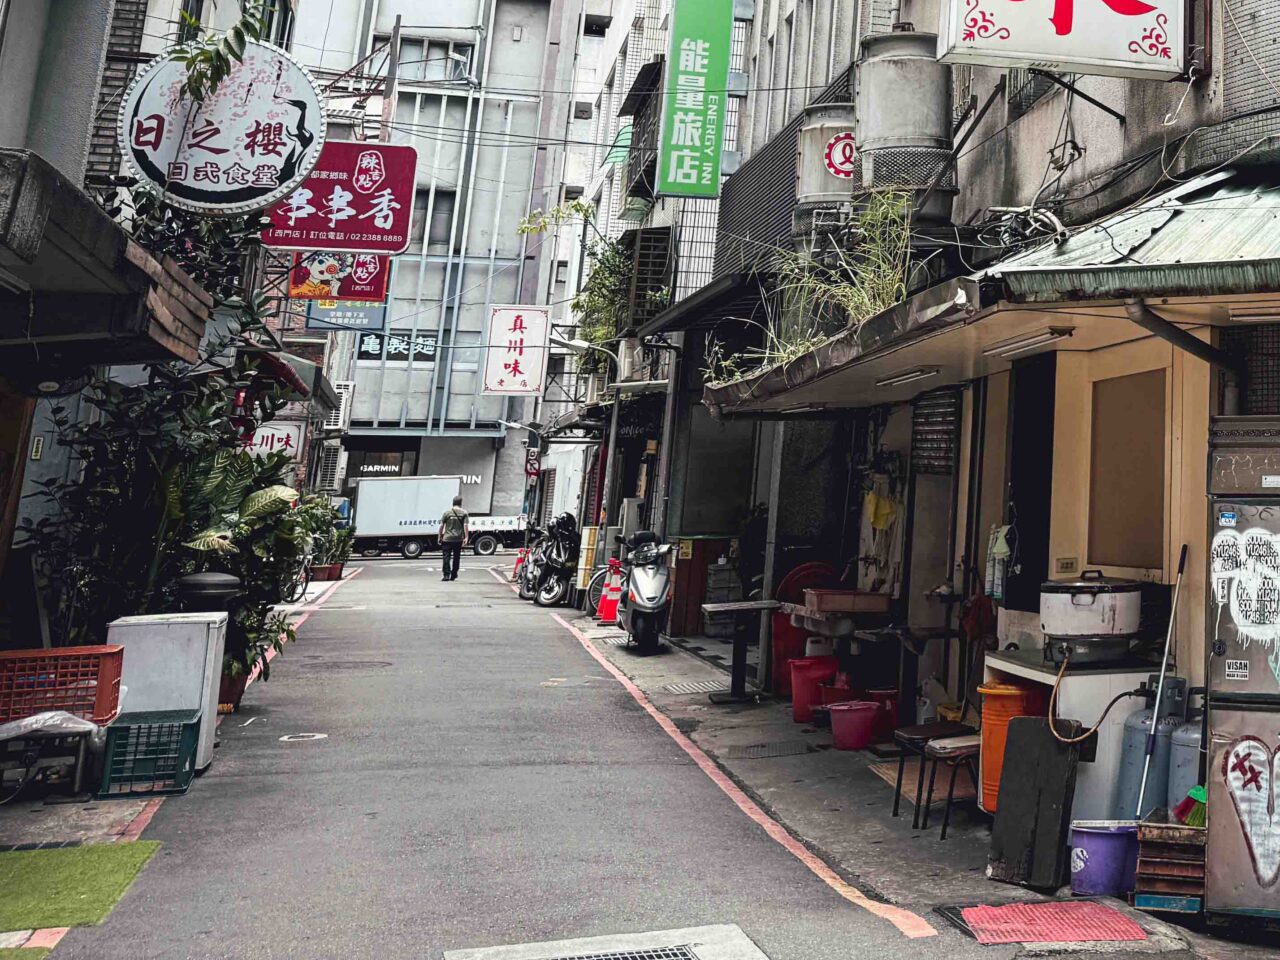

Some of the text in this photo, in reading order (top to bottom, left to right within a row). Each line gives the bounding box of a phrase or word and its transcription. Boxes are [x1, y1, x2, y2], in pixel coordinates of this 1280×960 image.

[667, 38, 710, 184] 能量旅店
[134, 113, 288, 158] 日之櫻
[701, 95, 719, 185] ENERGY INN
[166, 162, 281, 189] 日式食堂
[276, 185, 401, 230] 串串香
[504, 314, 528, 378] 真川味
[360, 464, 400, 472] GARMIN
[1227, 661, 1249, 671] VISAH
